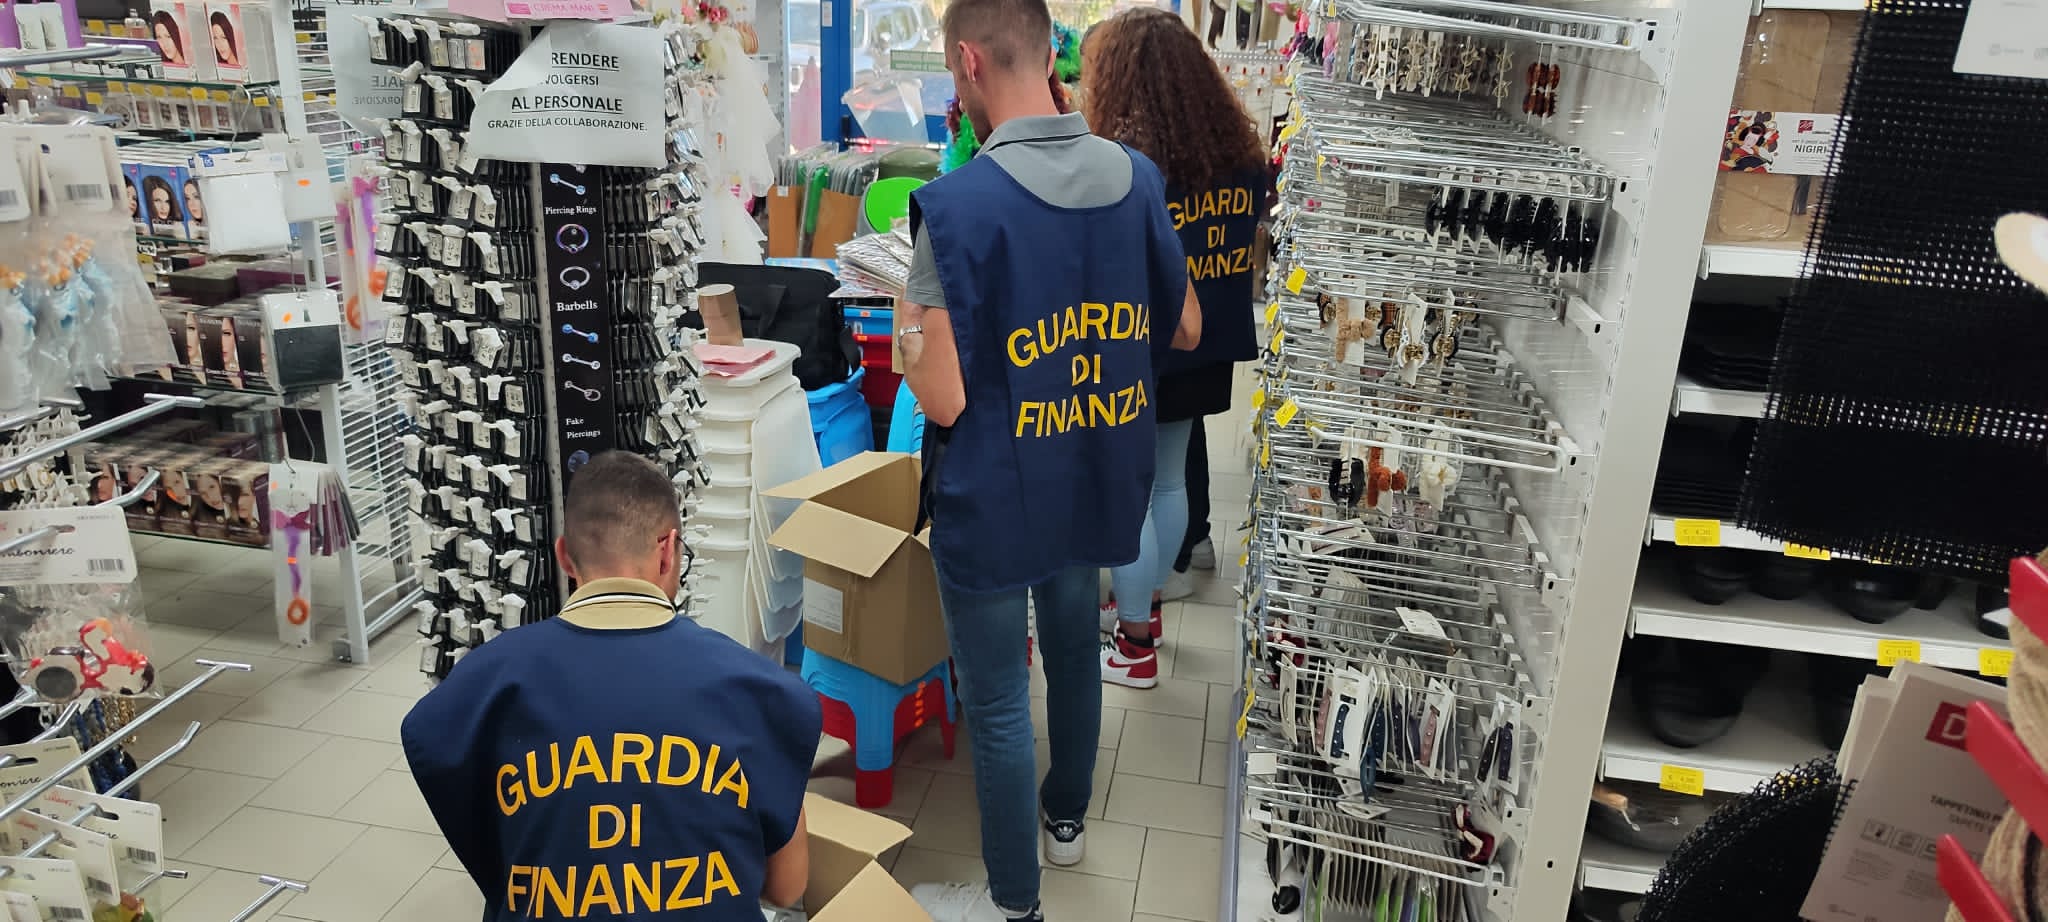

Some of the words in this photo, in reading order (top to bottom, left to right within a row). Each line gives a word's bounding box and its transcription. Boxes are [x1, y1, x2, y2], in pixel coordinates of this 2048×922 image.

[551, 52, 619, 69] RENDERE
[511, 96, 530, 110] AL
[535, 96, 623, 112] PERSONALE
[487, 118, 522, 129] GRAZIE
[525, 118, 551, 127] DELLA
[554, 116, 648, 131] COLLABORAZIONE.
[1794, 144, 1827, 153] NIGIRI
[545, 205, 575, 215] Piercing
[576, 205, 597, 215] Rings
[1167, 187, 1253, 231] GUARDI
[1207, 224, 1226, 248] DI
[1186, 244, 1254, 280] NANZA
[556, 300, 598, 311] Barbells
[1007, 302, 1150, 367] GUARDIA
[1071, 354, 1101, 387] DI
[1016, 379, 1148, 437] FINANZA
[567, 430, 601, 439] Piercings
[497, 733, 749, 816] GUARDIA
[589, 803, 641, 849] DI
[507, 851, 742, 918] FINANZA
